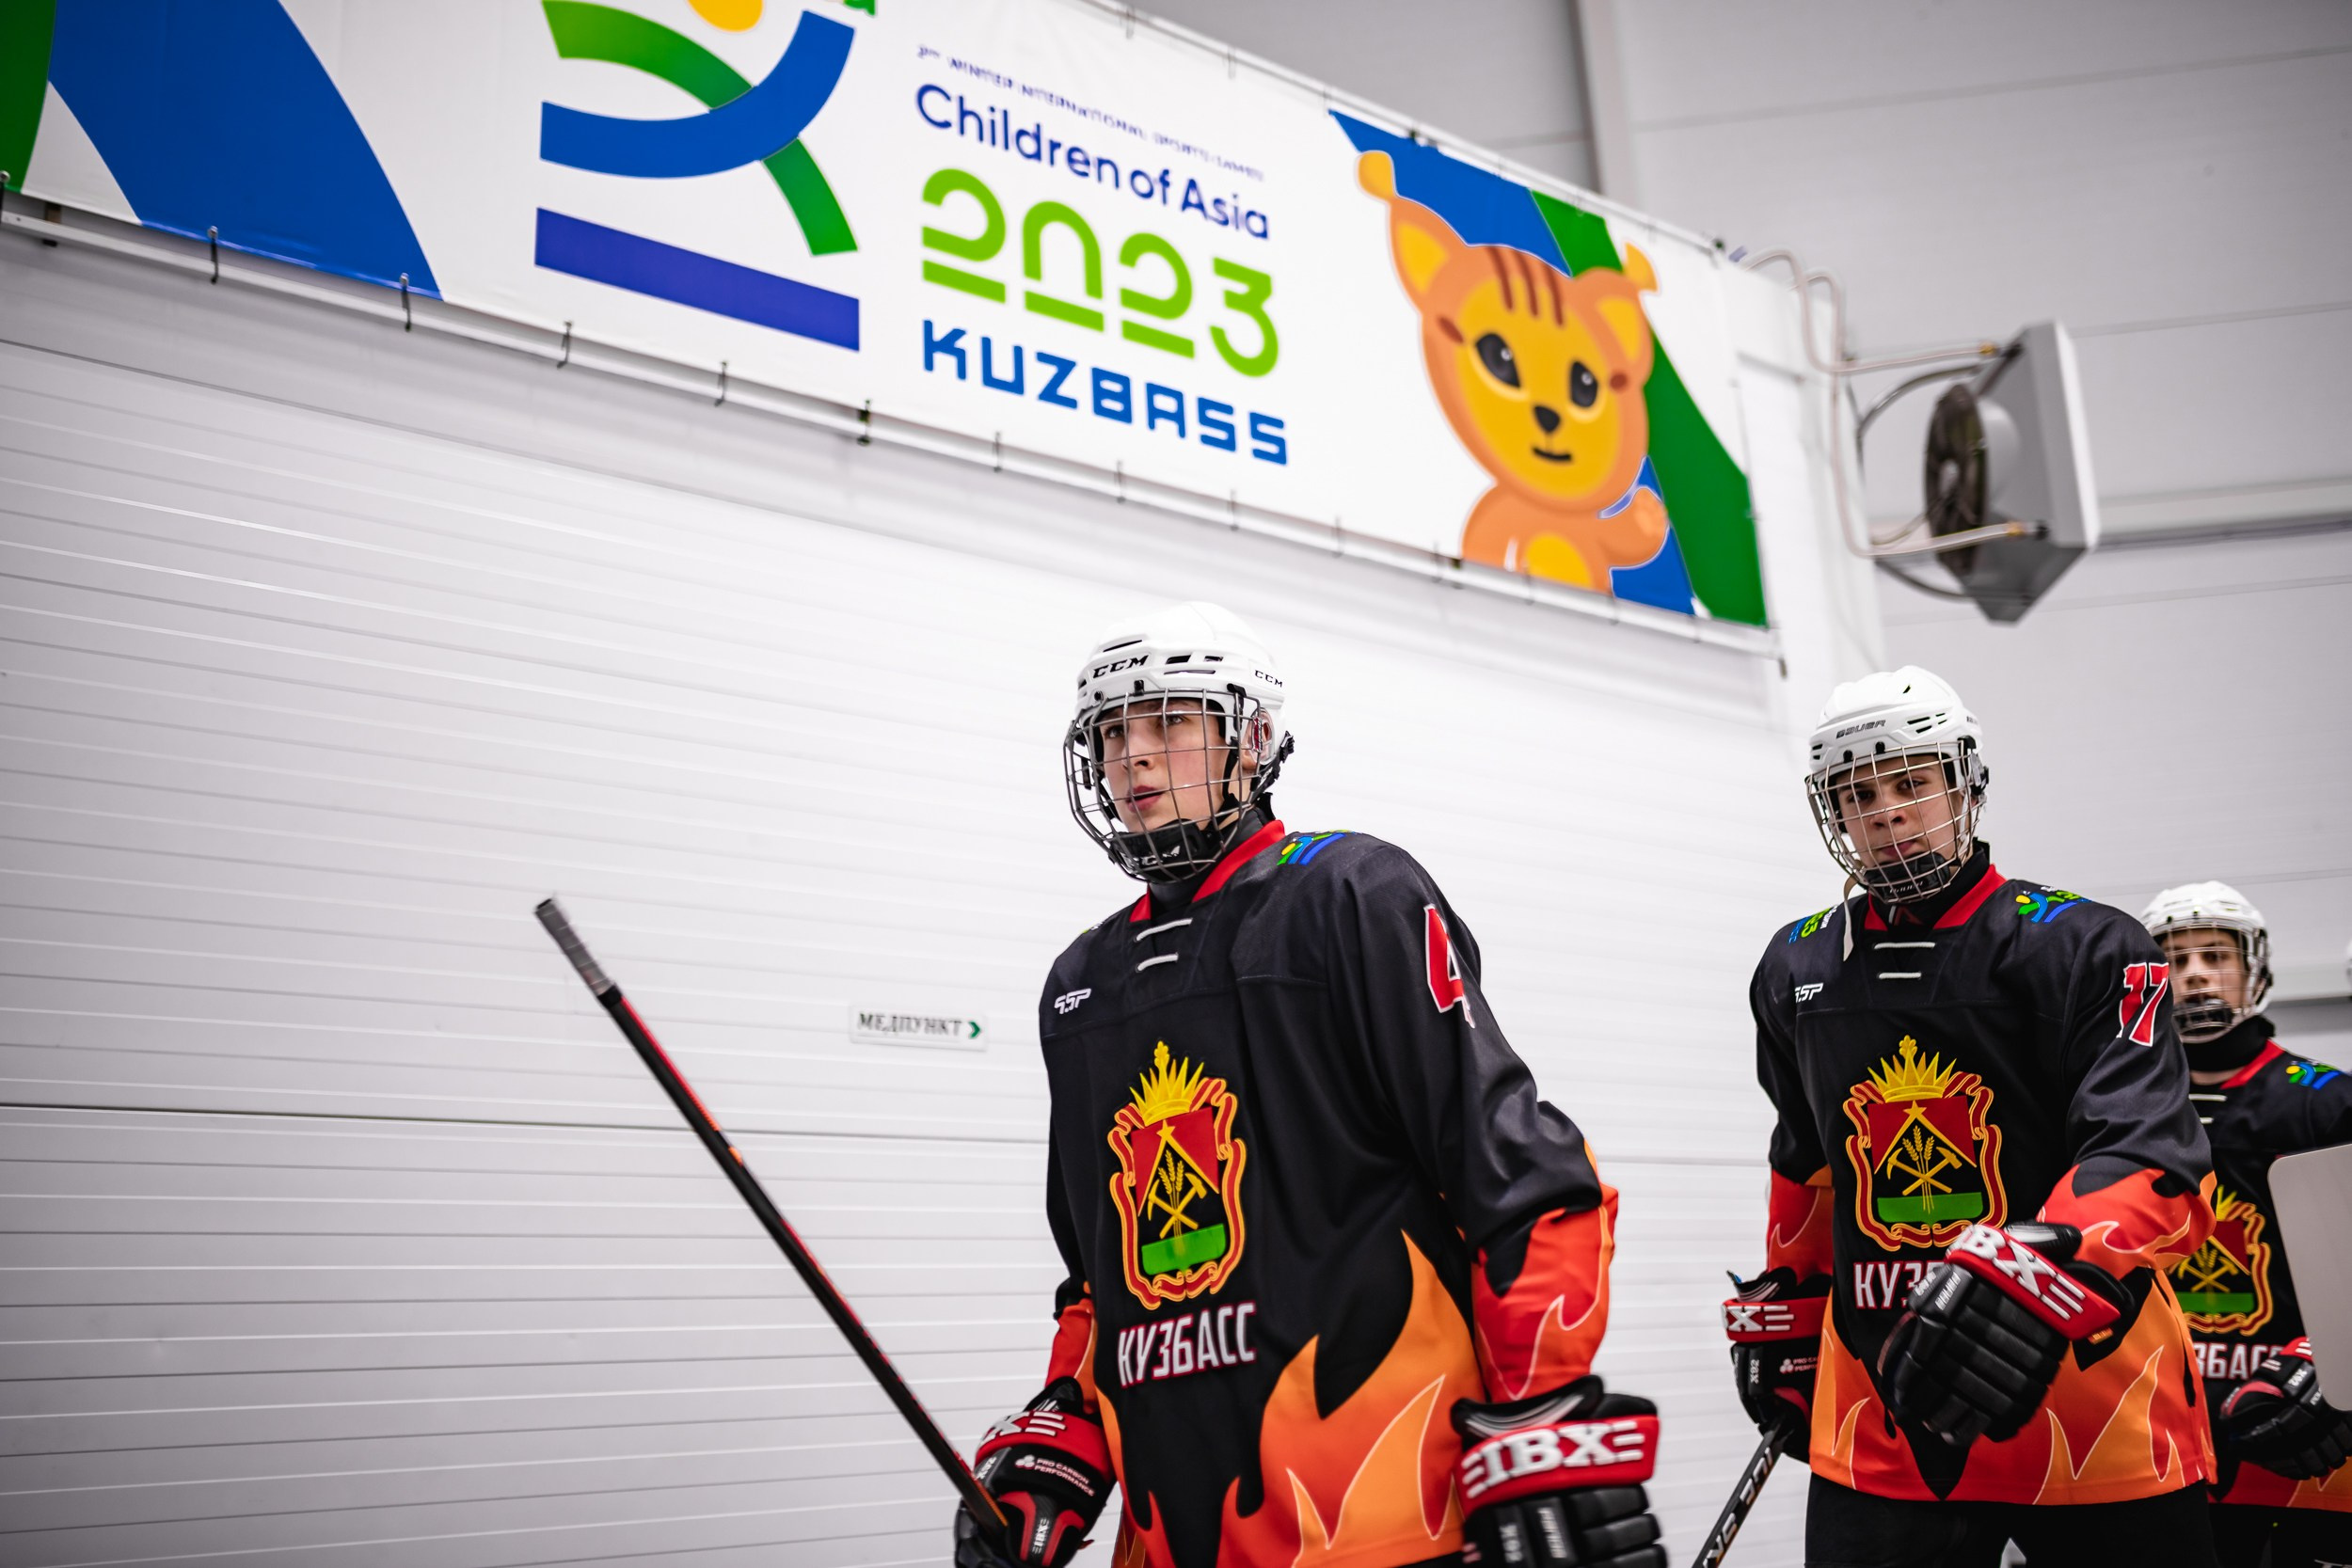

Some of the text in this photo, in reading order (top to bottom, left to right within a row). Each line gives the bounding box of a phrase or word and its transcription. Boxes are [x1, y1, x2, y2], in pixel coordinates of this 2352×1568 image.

[915, 84, 1270, 241] Children of Asia
[921, 167, 1279, 378] 2023
[922, 318, 1288, 466] KUZBASS
[1092, 655, 1149, 679] CCM
[1254, 669, 1283, 689] CCM
[1423, 903, 1475, 1029] 4
[857, 1012, 962, 1037] МЕДПУНКТ
[2116, 961, 2169, 1048] 17
[1118, 1301, 1257, 1389] КУЗБАСС
[1034, 1465, 1094, 1497] PERFORMANCE
[1037, 1458, 1089, 1485] PRO CARBON
[1480, 1423, 1616, 1488] IBX
